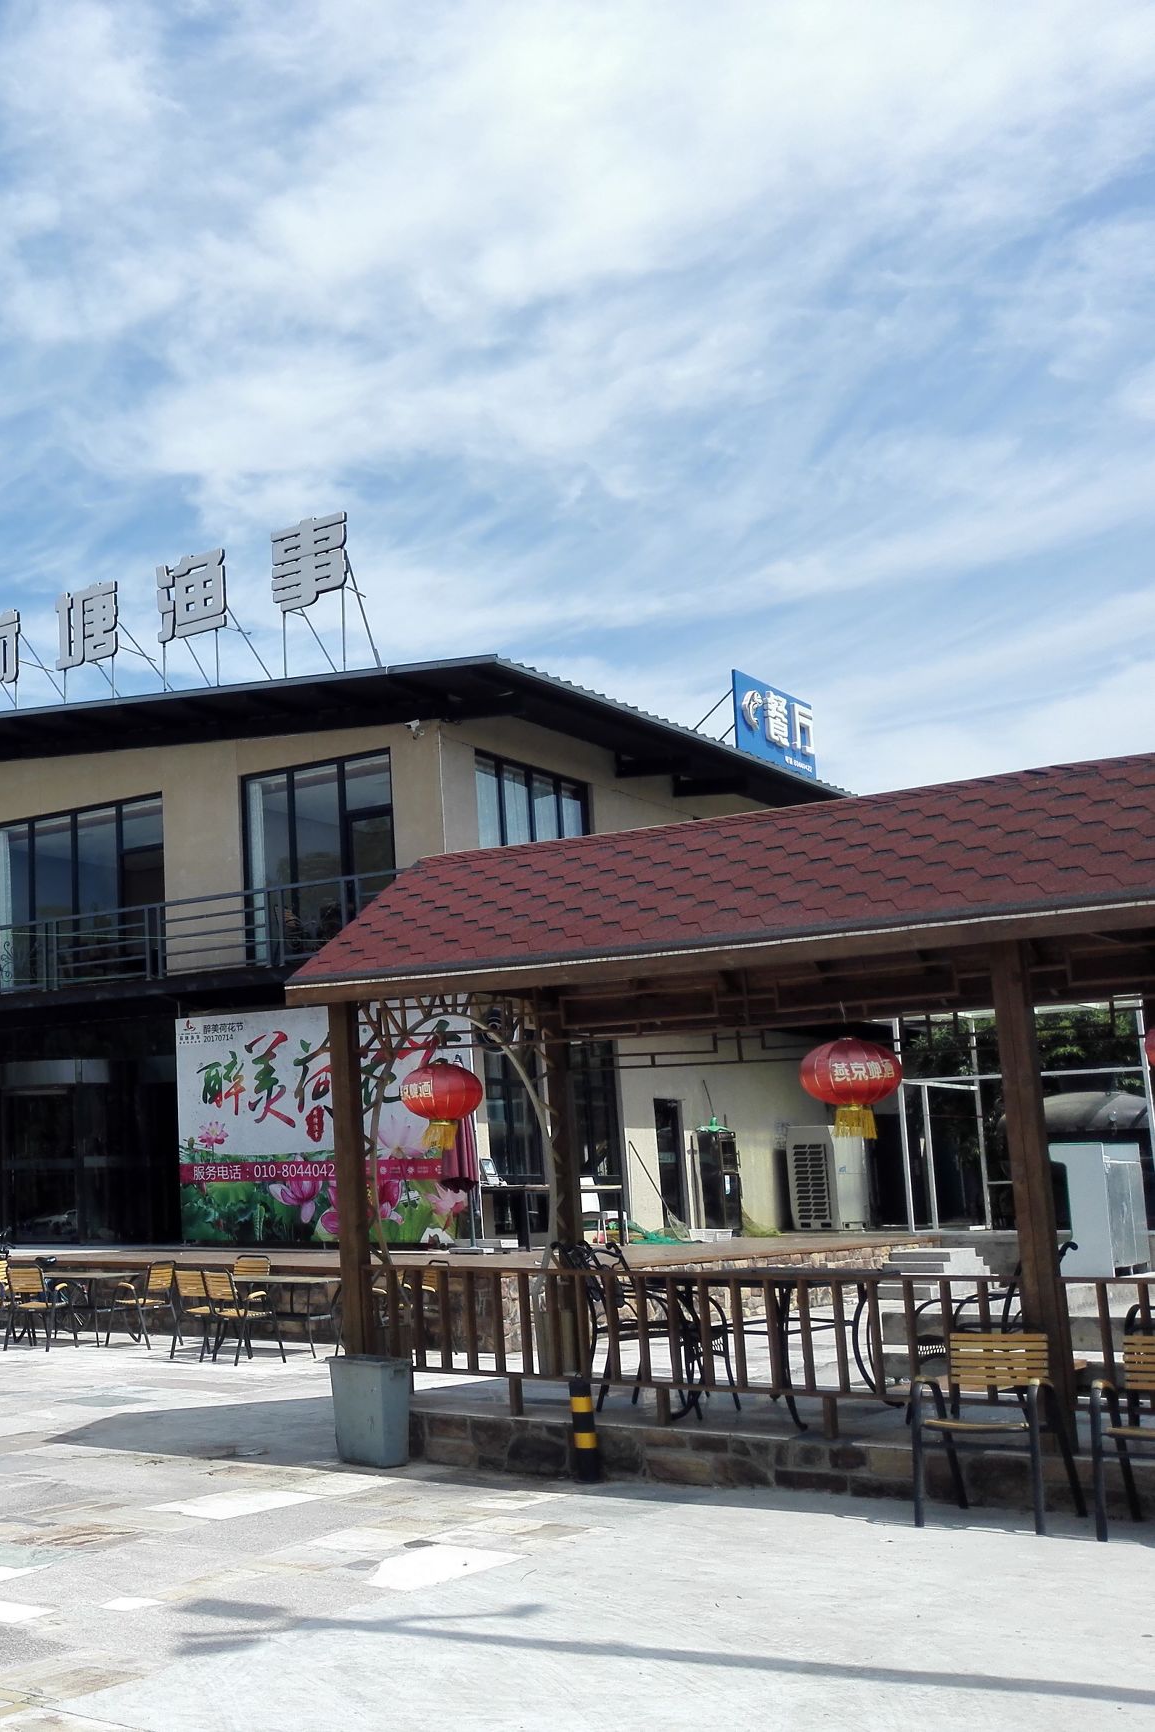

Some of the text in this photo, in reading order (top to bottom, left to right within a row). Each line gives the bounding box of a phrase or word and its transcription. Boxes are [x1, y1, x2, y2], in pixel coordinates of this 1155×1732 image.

[763, 690, 815, 755] 餐厅
[203, 1022, 244, 1034] 醉美荷花节
[203, 1034, 234, 1043] 20170714
[832, 1059, 894, 1082] 燕京啤酒
